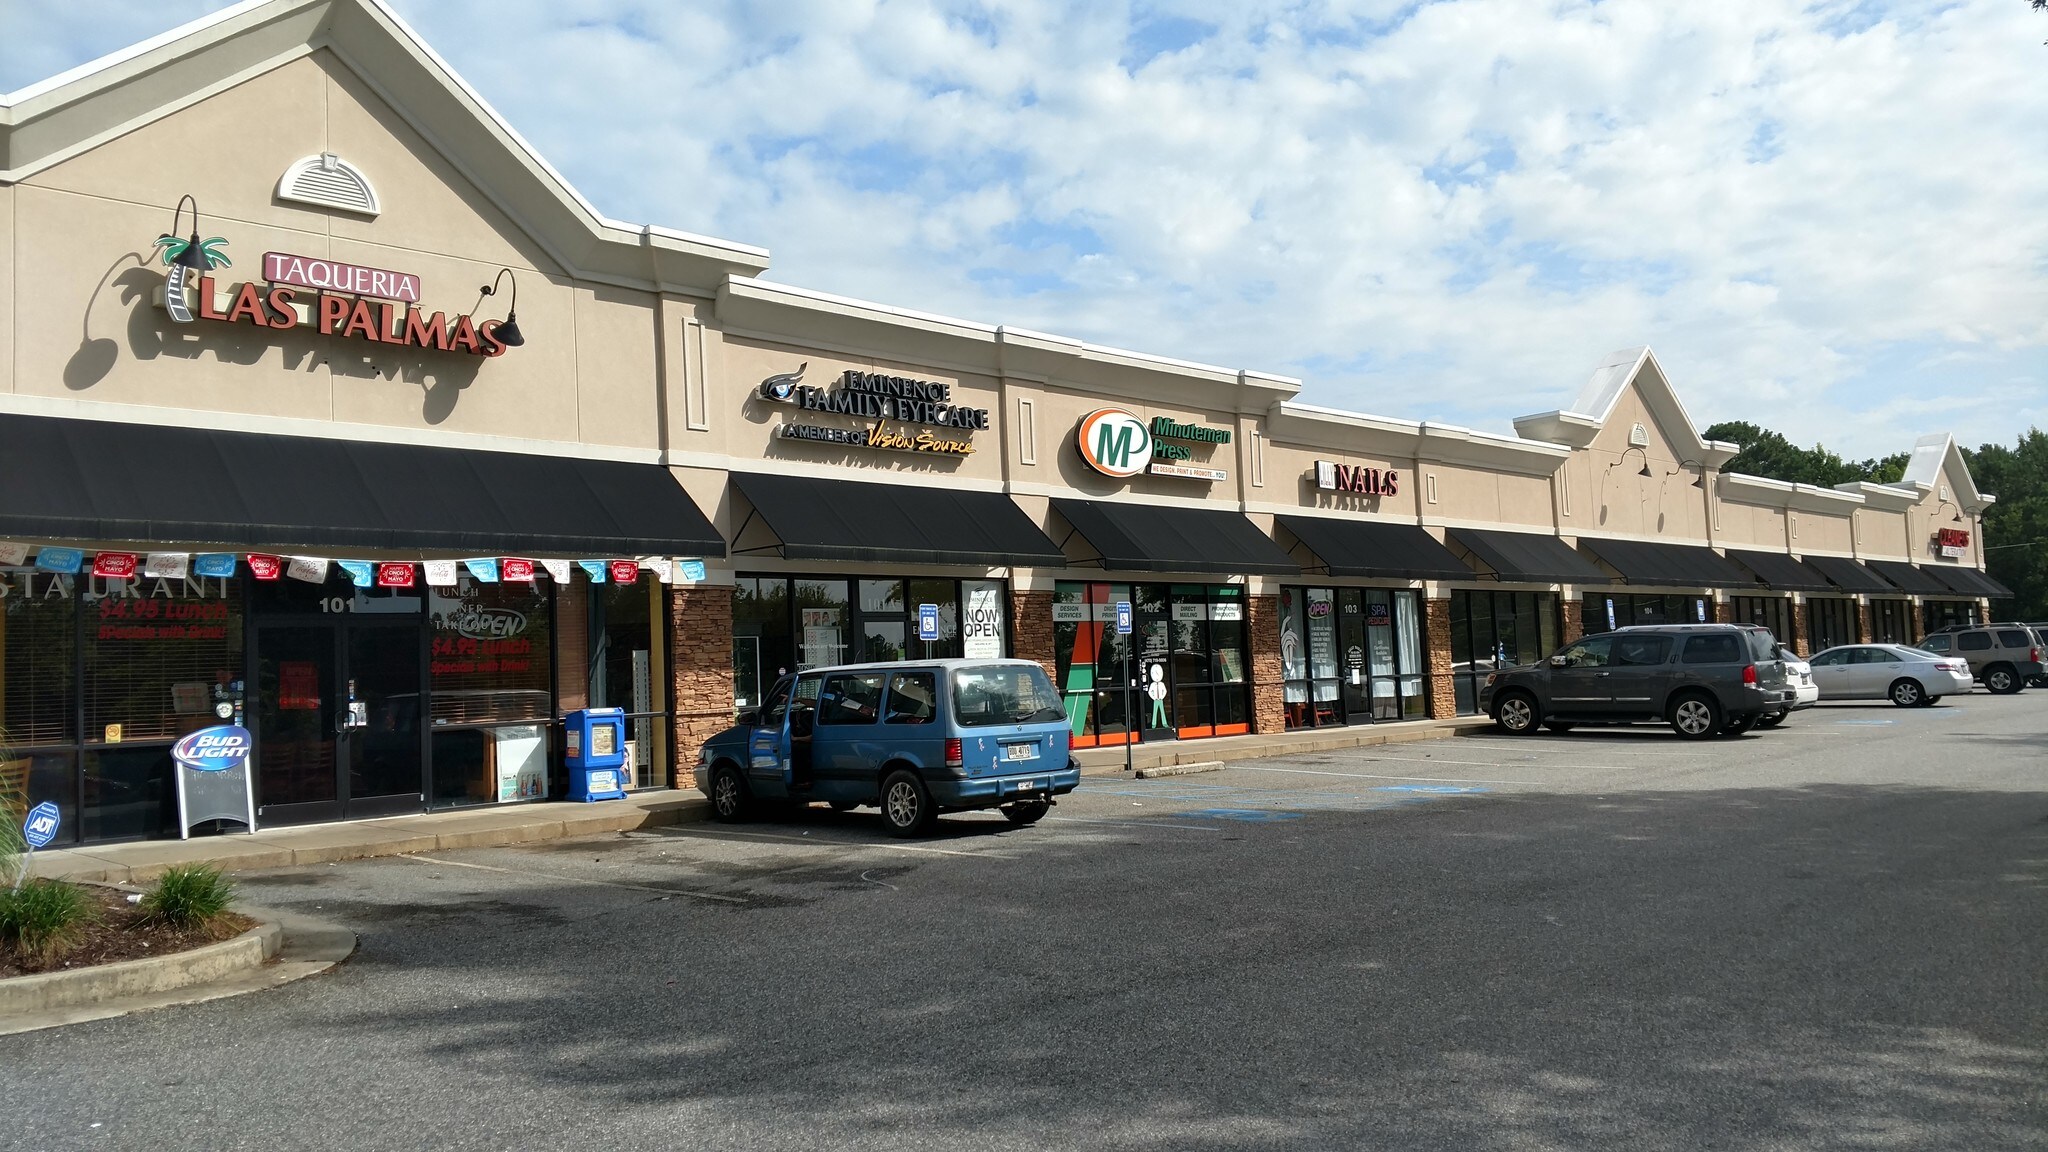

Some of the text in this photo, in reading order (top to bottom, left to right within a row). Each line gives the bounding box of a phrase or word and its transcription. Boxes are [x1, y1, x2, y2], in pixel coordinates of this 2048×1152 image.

[269, 254, 417, 301] TAQUERIA
[199, 275, 508, 358] LAS PALMAS
[847, 370, 951, 402] EMINENCE
[800, 385, 989, 431] FAMILY EYECARE
[787, 424, 797, 436] A
[799, 425, 849, 443] MEMBER
[850, 430, 868, 444] OF
[1153, 416, 1232, 444] Minuteman
[1152, 438, 1192, 461] Press
[1337, 463, 1399, 497] NAILS
[100, 597, 228, 619] $4.95 Lunch
[319, 597, 355, 613] 101
[1310, 602, 1330, 616] OPEN
[1344, 604, 1358, 614] 103
[1371, 604, 1387, 616] SPA
[463, 612, 520, 636] OPEN
[966, 608, 998, 623] NOW
[964, 623, 1000, 638] OPEN
[432, 636, 530, 656] $4.95 Lunch
[196, 735, 243, 748] BUD
[186, 746, 250, 759] LIGHT
[30, 816, 56, 834] ADT
